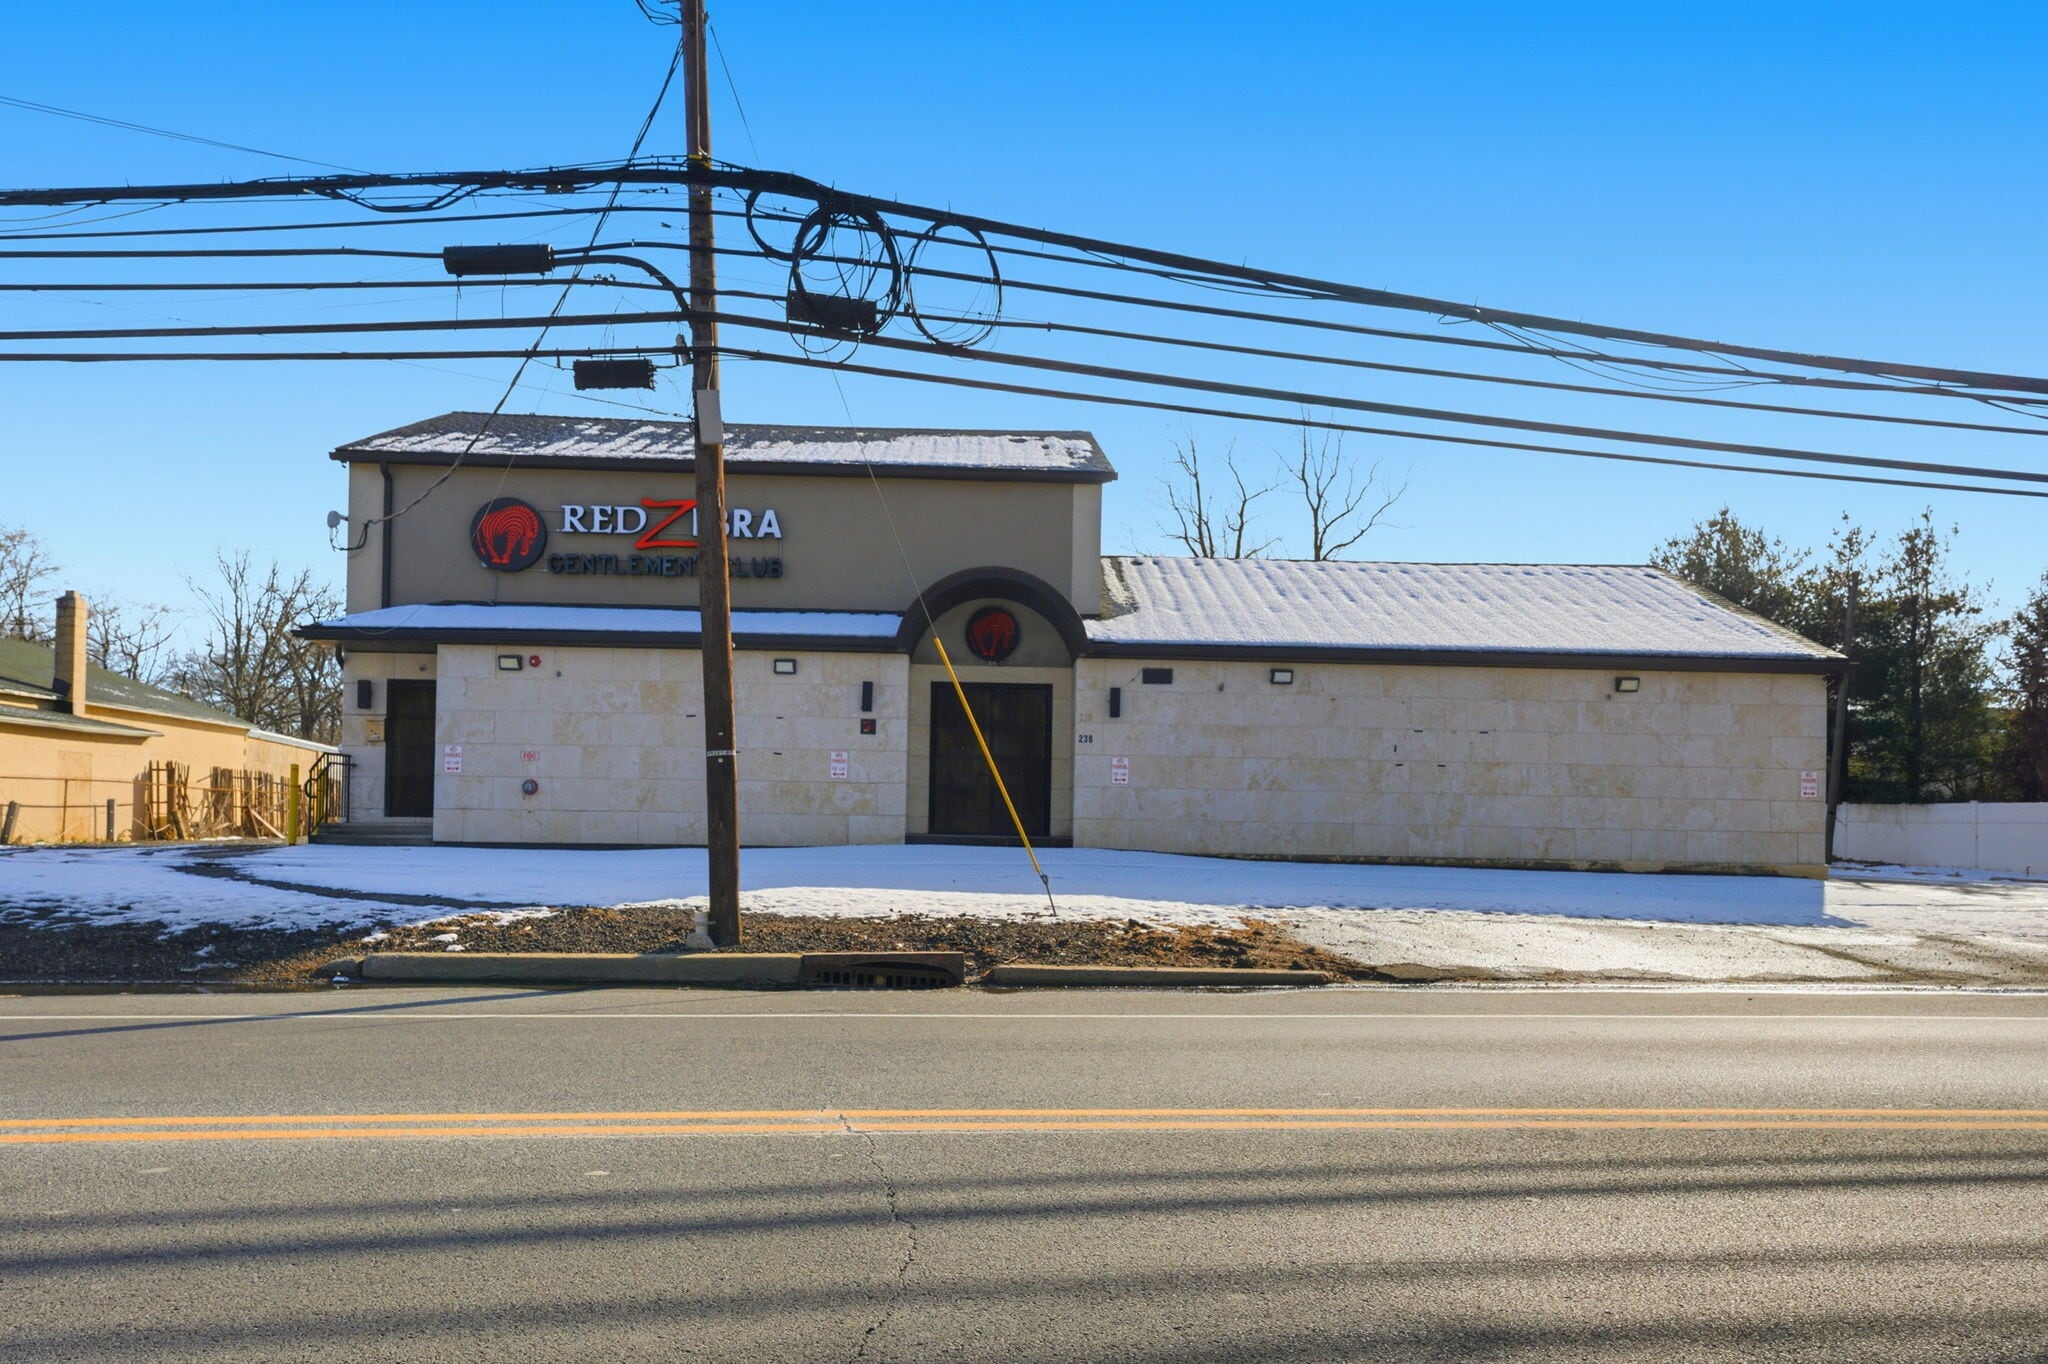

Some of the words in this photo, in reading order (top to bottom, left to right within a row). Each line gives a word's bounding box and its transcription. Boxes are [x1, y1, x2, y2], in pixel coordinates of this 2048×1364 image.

[560, 504, 647, 534] RED
[634, 497, 782, 550] ZRA
[547, 552, 699, 577] GENTLEMEN'
[1078, 734, 1093, 744] 238
